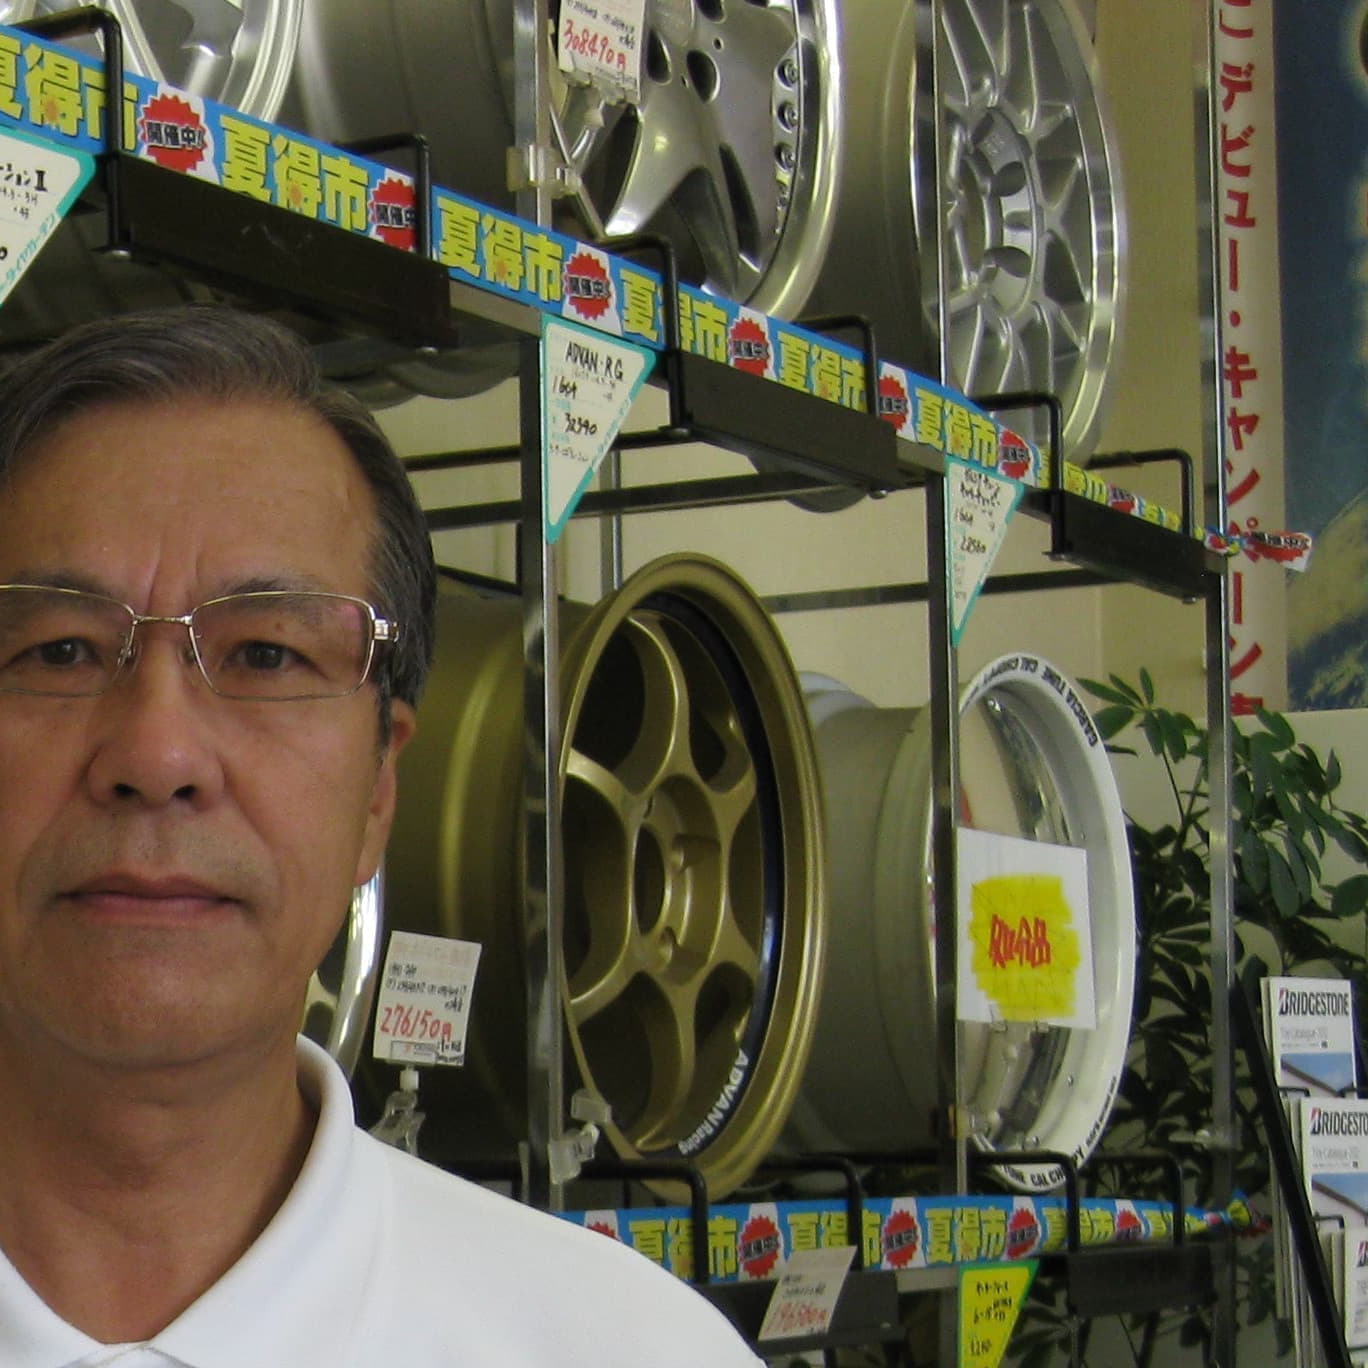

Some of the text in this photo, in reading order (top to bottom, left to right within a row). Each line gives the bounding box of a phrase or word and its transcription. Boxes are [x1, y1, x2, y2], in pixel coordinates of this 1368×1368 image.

[147, 120, 205, 150] 開催中!
[220, 115, 369, 232] 夏得市
[437, 196, 564, 304] 夏得市
[916, 388, 998, 467] 夏得市
[1279, 987, 1350, 1017] BRIDGESTONE
[708, 1048, 749, 1127] ADVAN
[925, 1206, 1007, 1263] 夏得市
